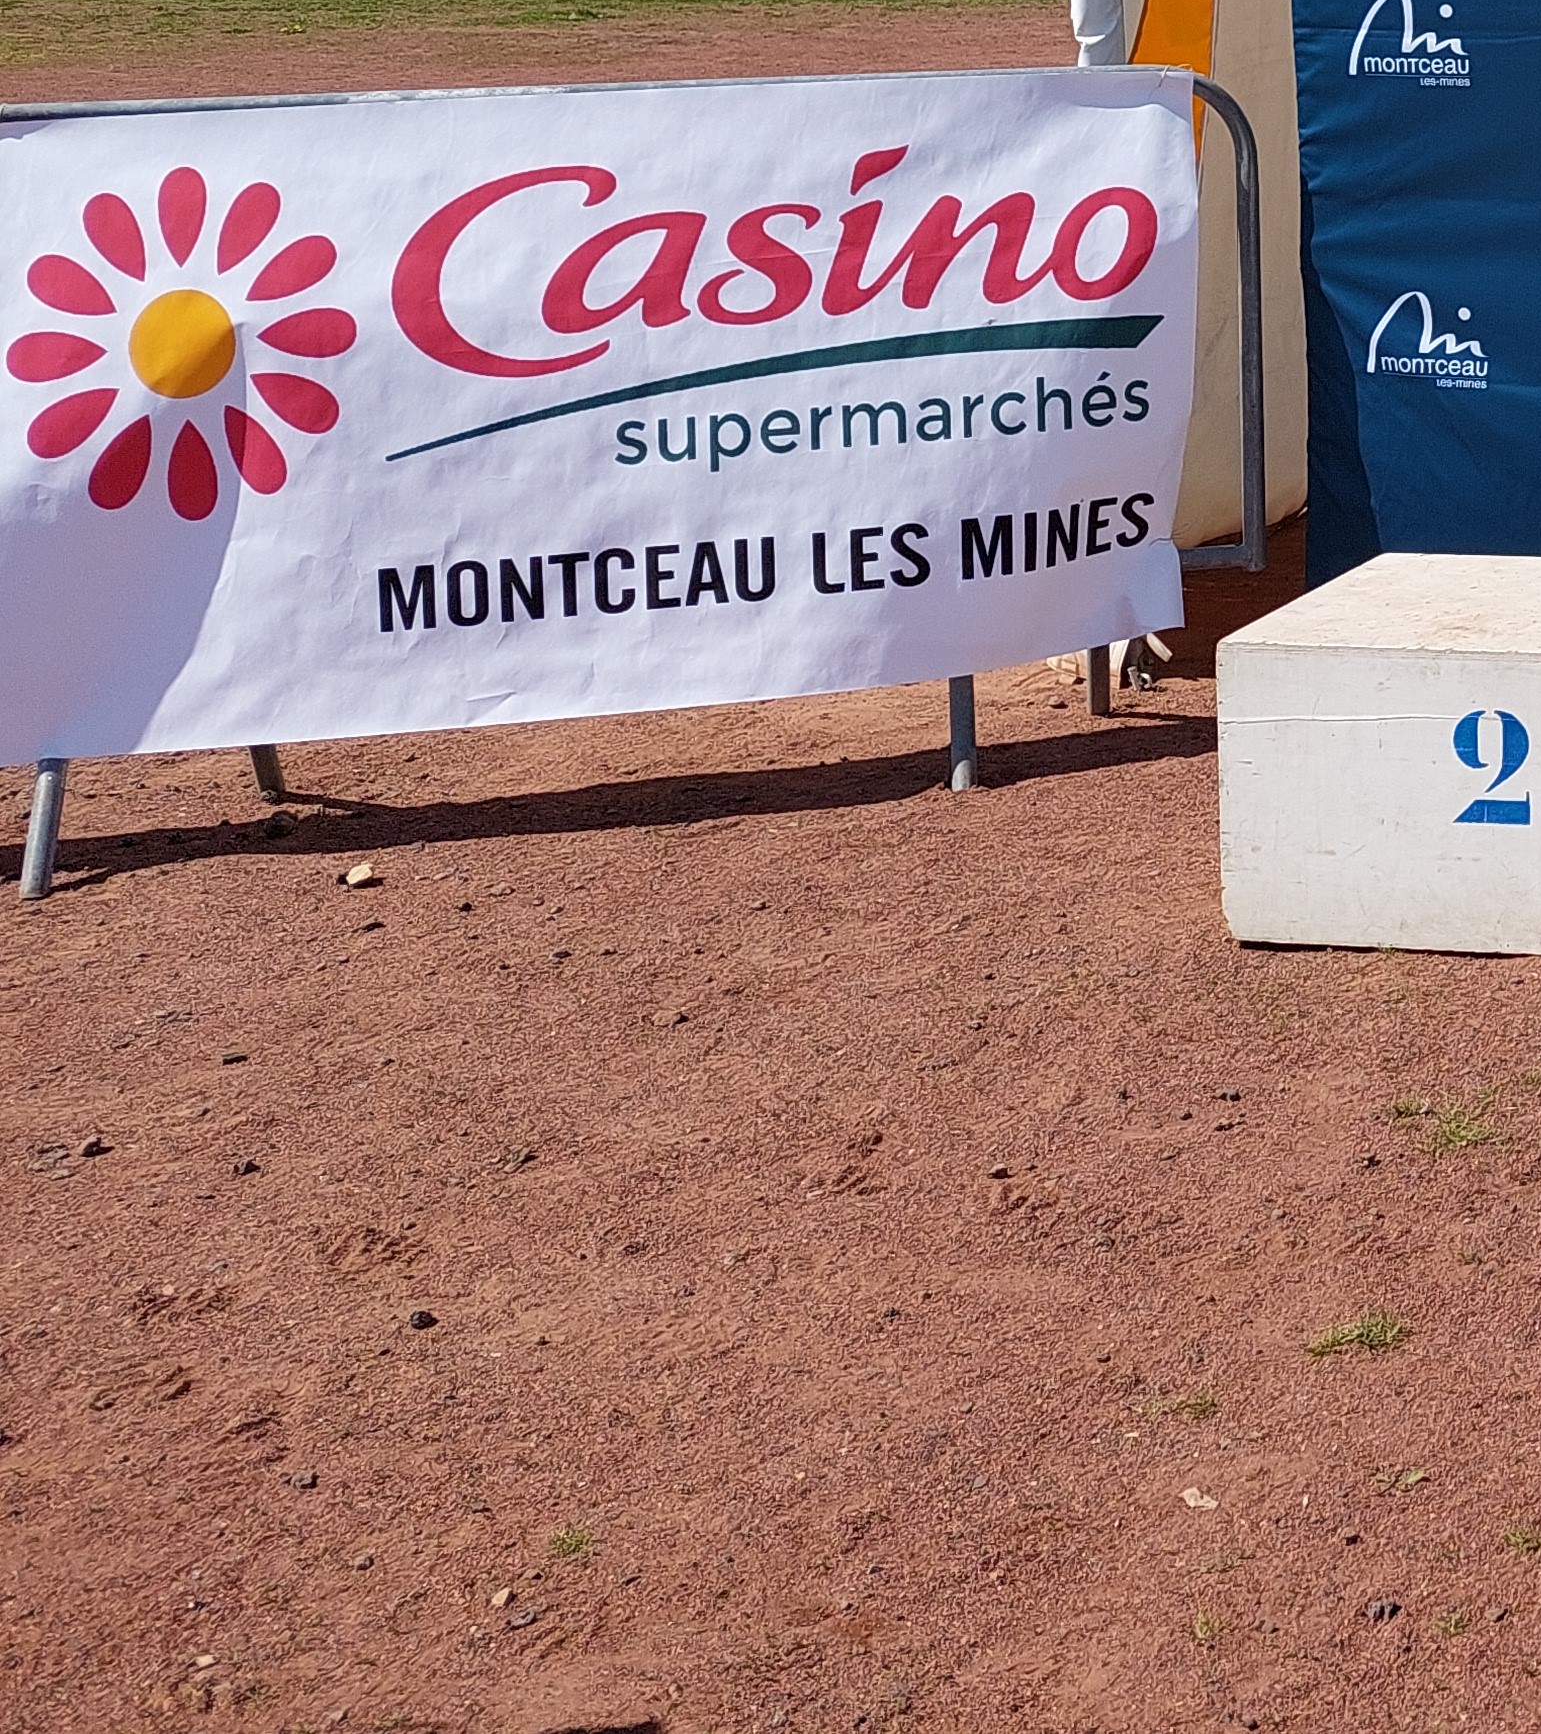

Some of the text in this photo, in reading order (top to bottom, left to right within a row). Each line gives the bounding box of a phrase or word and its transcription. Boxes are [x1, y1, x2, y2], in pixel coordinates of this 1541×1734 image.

[391, 144, 1159, 378] Casino
[614, 371, 1151, 472] supermarchés
[376, 491, 1157, 634] MONTCEAU LES MINES
[1452, 709, 1531, 826] 2
